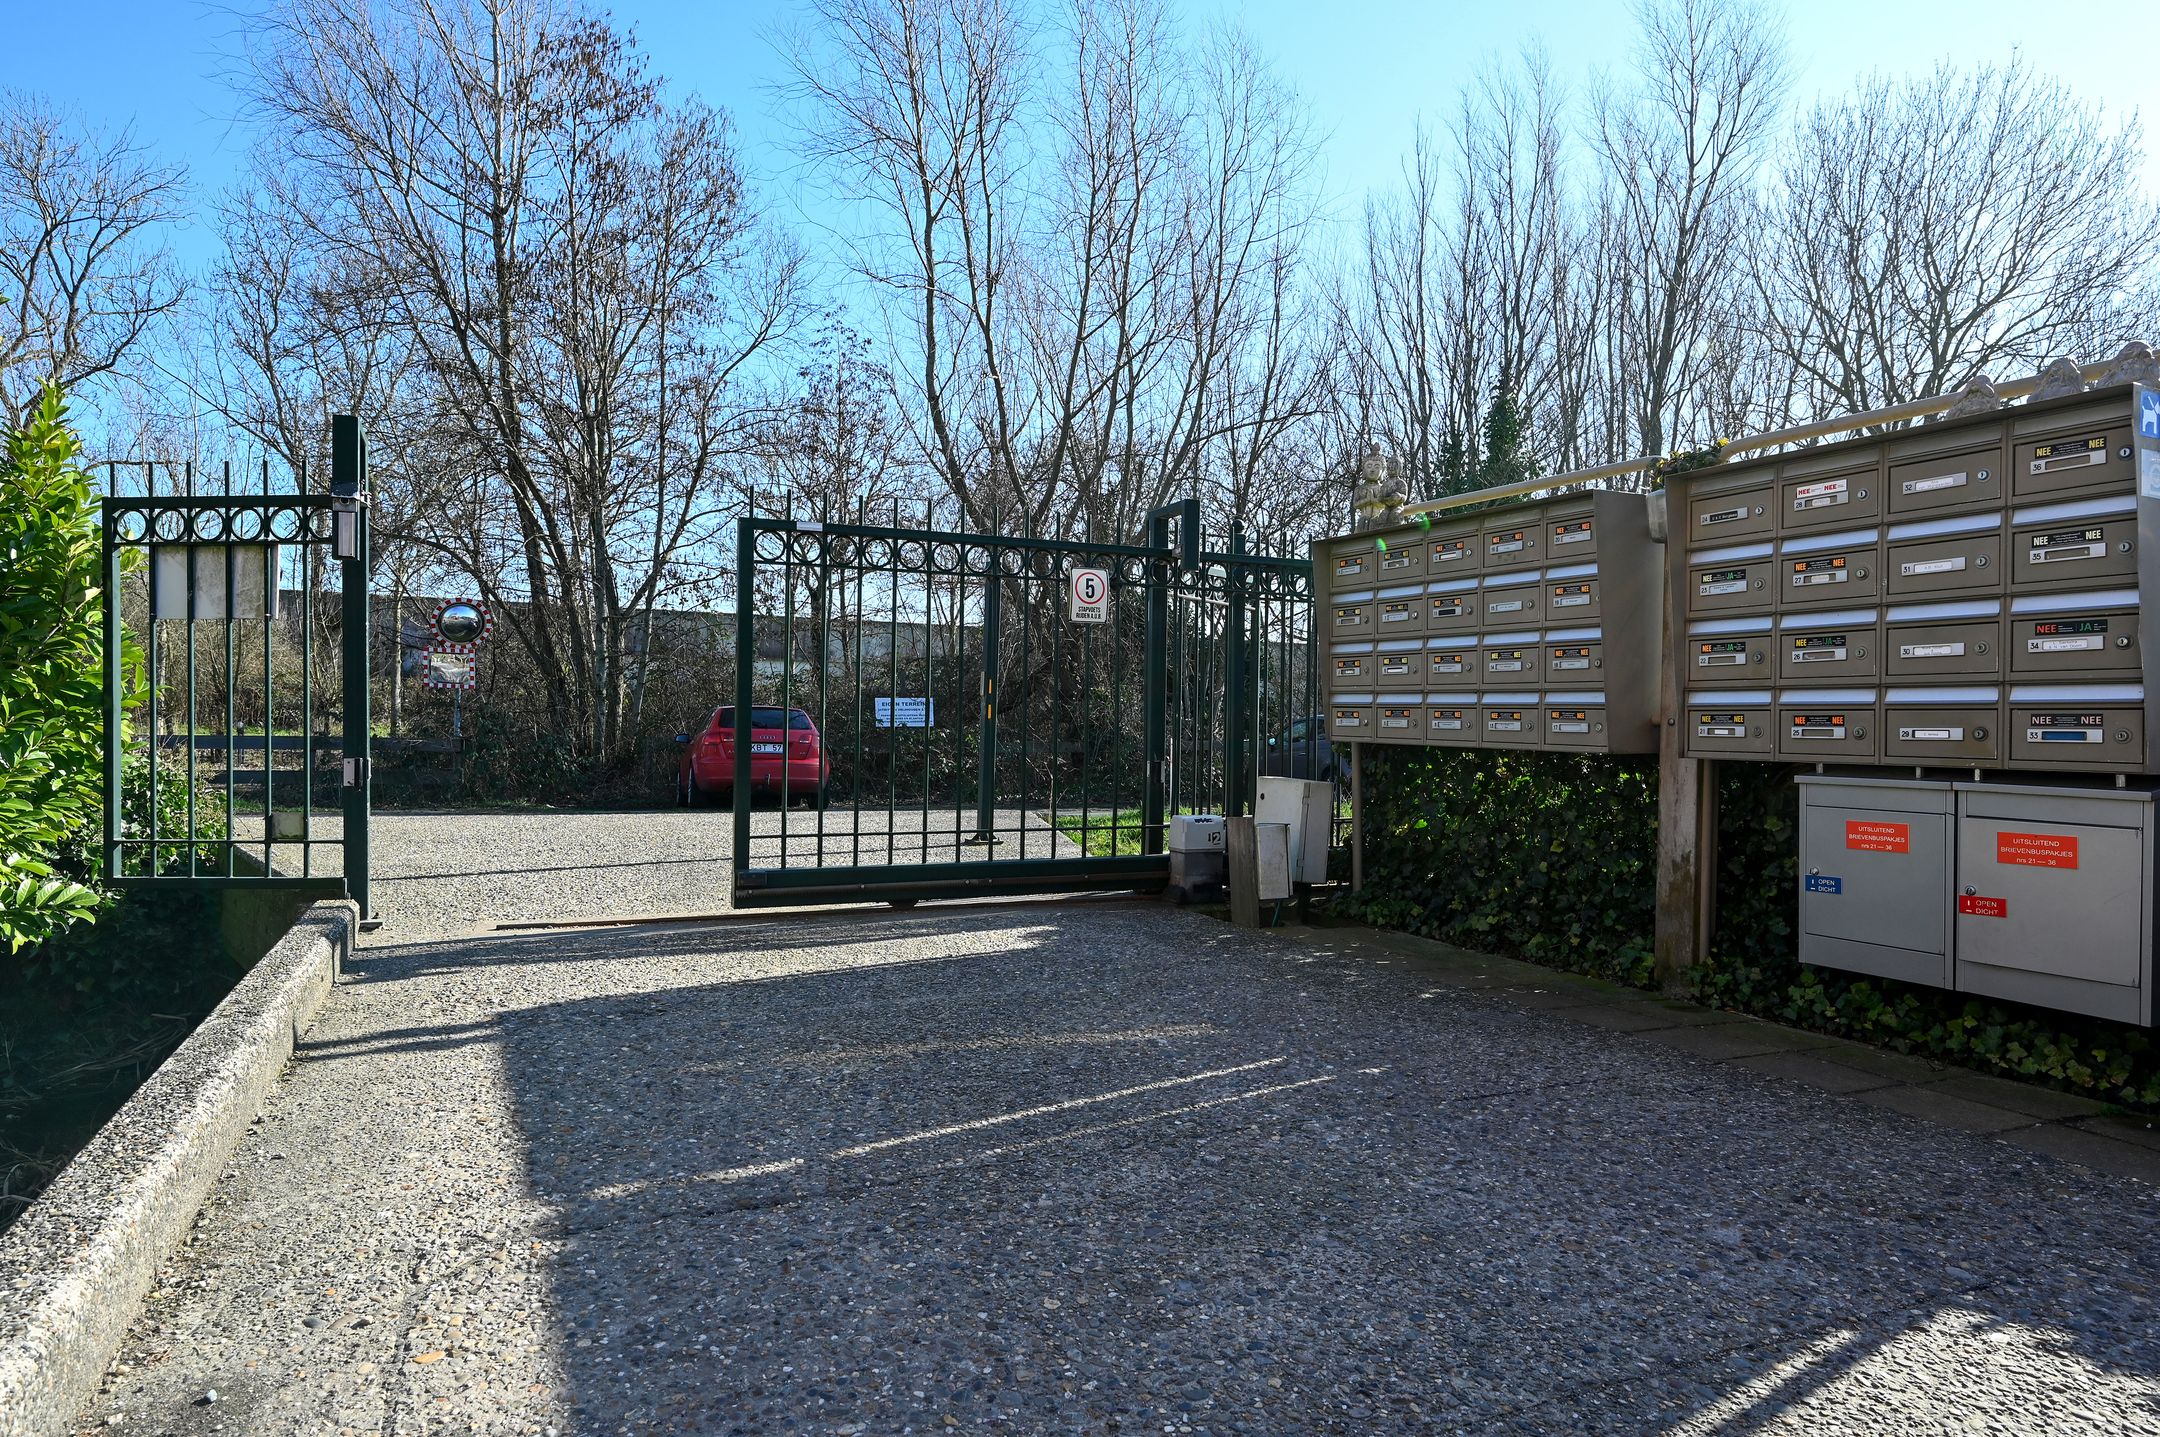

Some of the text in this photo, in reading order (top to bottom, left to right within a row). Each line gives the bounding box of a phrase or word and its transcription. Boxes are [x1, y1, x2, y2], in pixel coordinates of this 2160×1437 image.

[2036, 447, 2052, 457] NEE
[2088, 438, 2105, 449] NEE
[2033, 536, 2049, 546] NEE
[2085, 529, 2101, 540] NEE
[1795, 563, 1807, 571] NEE
[1832, 558, 1845, 567] NEE
[1702, 574, 1712, 583] NEE
[1086, 577, 1095, 598] 5
[2036, 624, 2057, 633] NEE
[2080, 622, 2092, 632] JA
[1796, 639, 1807, 647] NEE
[1702, 644, 1712, 652] NEE
[1701, 715, 1711, 723] NEE
[1733, 715, 1744, 723] NEE
[1795, 716, 1806, 724] NEE
[1832, 716, 1844, 724] NEE
[2032, 716, 2052, 724] NEE
[2081, 716, 2102, 724] NEE
[1858, 826, 1895, 834] UITSLUITEND
[1848, 834, 1905, 843] BRIEVENBUSPAKJES
[2012, 838, 2060, 847] UITSLUITEND
[2000, 847, 2073, 858] BRIEVENBUSPAKJES
